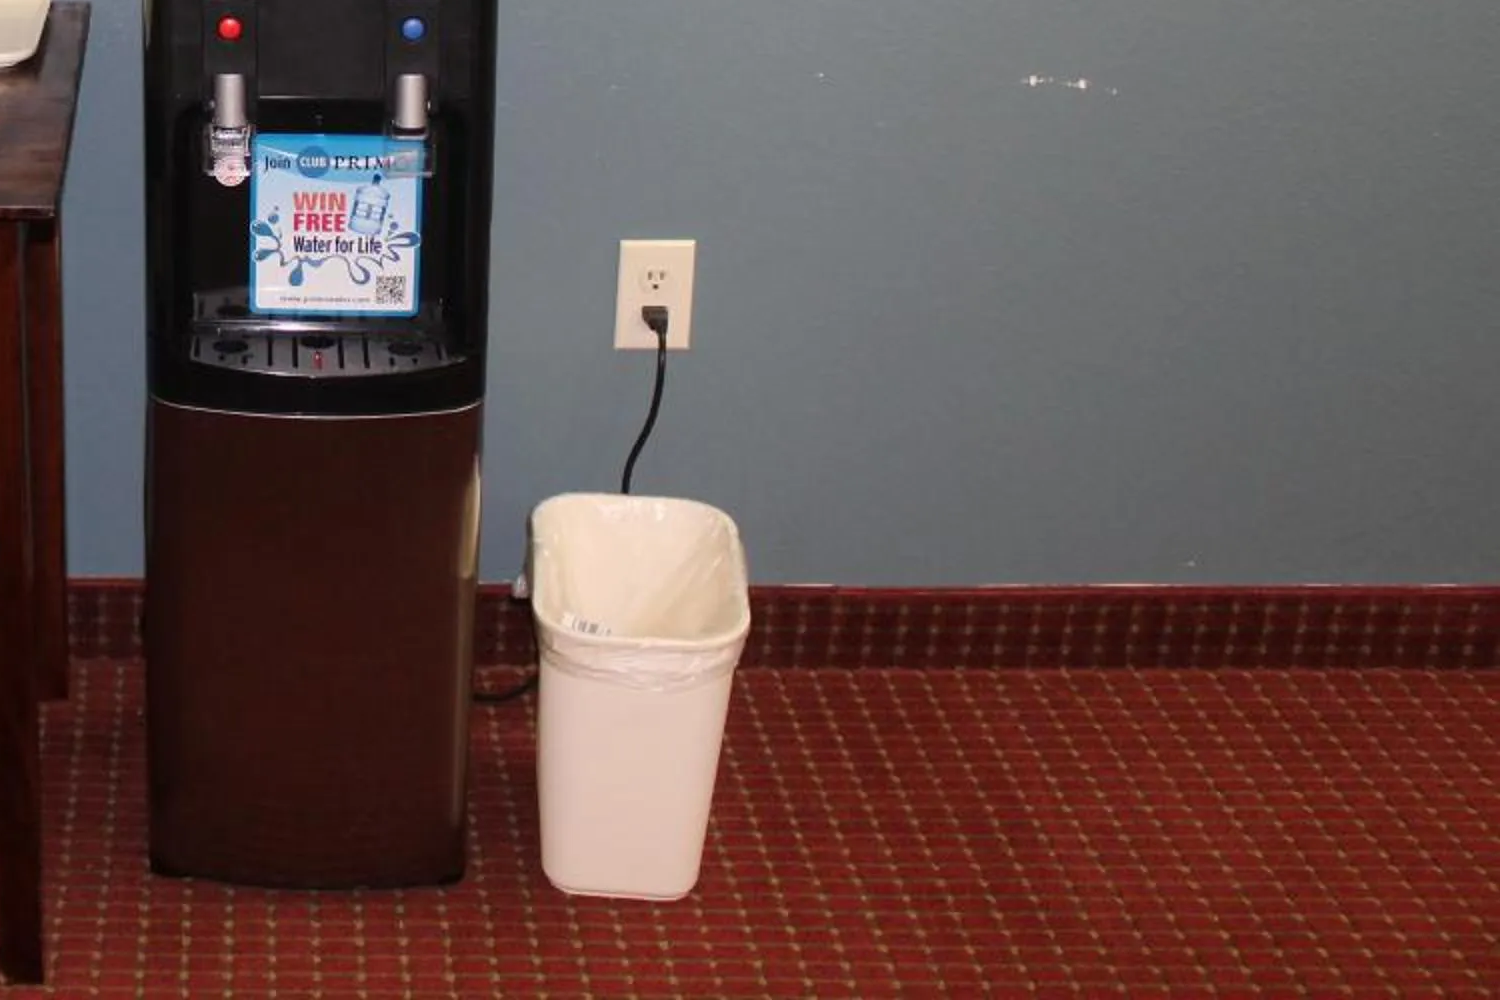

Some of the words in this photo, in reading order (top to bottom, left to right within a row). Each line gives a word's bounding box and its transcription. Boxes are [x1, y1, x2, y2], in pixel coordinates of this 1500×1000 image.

[264, 156, 292, 172] Join
[300, 155, 328, 169] CLUB
[334, 155, 397, 170] PRIM
[293, 191, 347, 212] WIN
[293, 213, 347, 233] FREE
[293, 235, 333, 253] Water
[334, 235, 354, 253] for
[357, 234, 383, 255] Life
